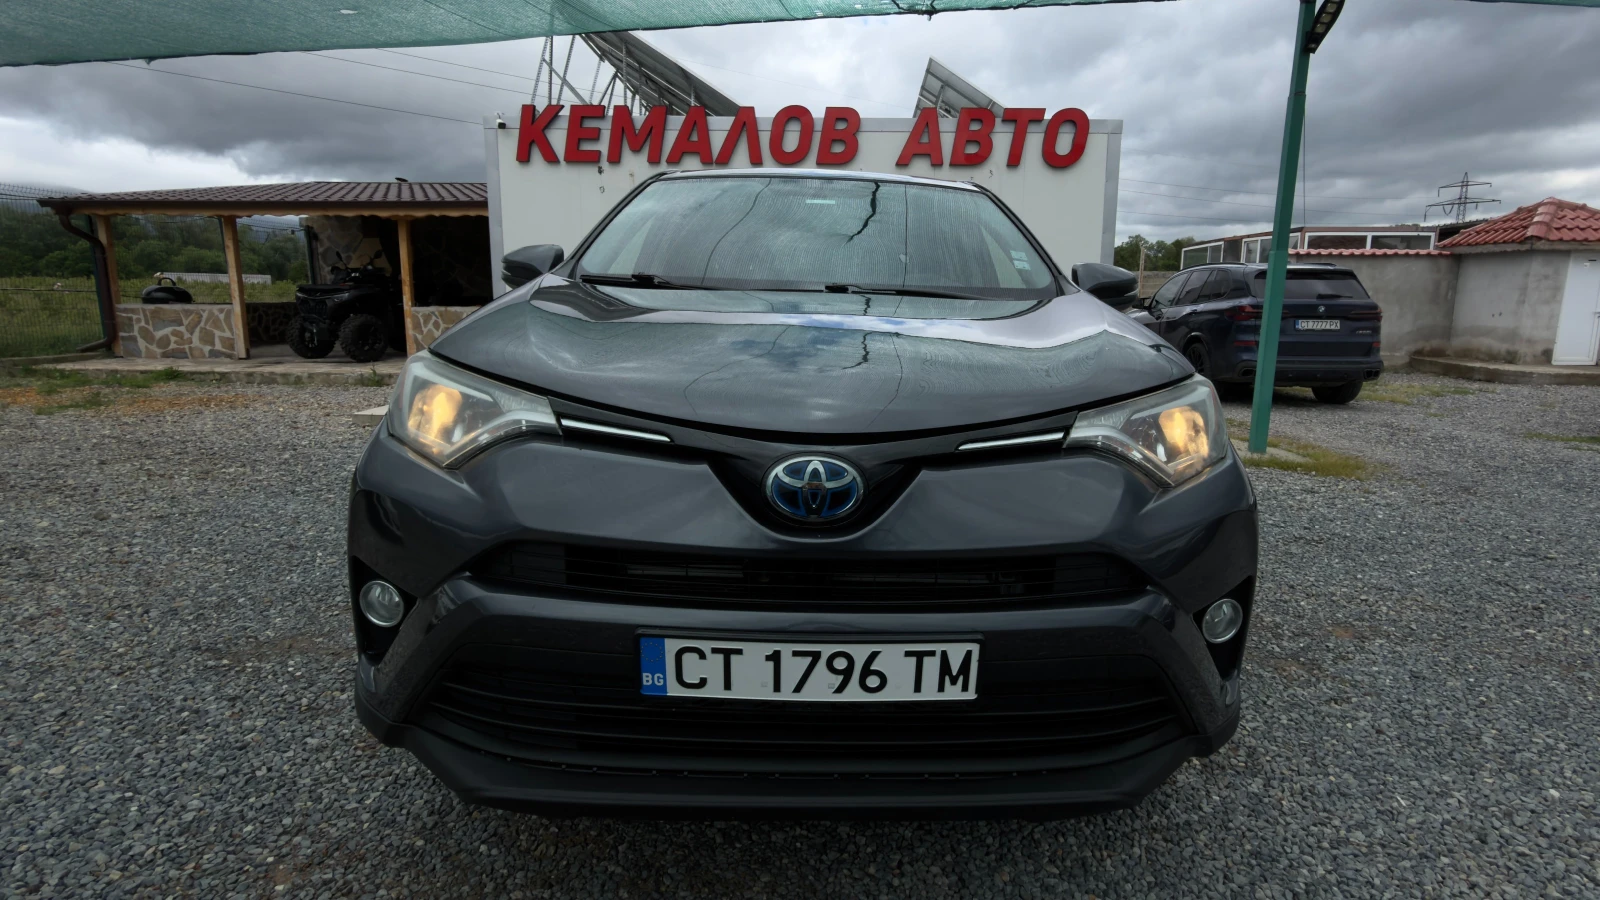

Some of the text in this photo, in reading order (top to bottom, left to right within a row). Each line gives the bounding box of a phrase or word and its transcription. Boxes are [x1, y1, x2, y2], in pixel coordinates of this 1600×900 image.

[516, 104, 1090, 168] КЕМАЛОВ АВТО
[1301, 320, 1339, 328] CT 7777 PX
[642, 672, 664, 687] BG
[674, 645, 973, 694] CT 1796 TM
